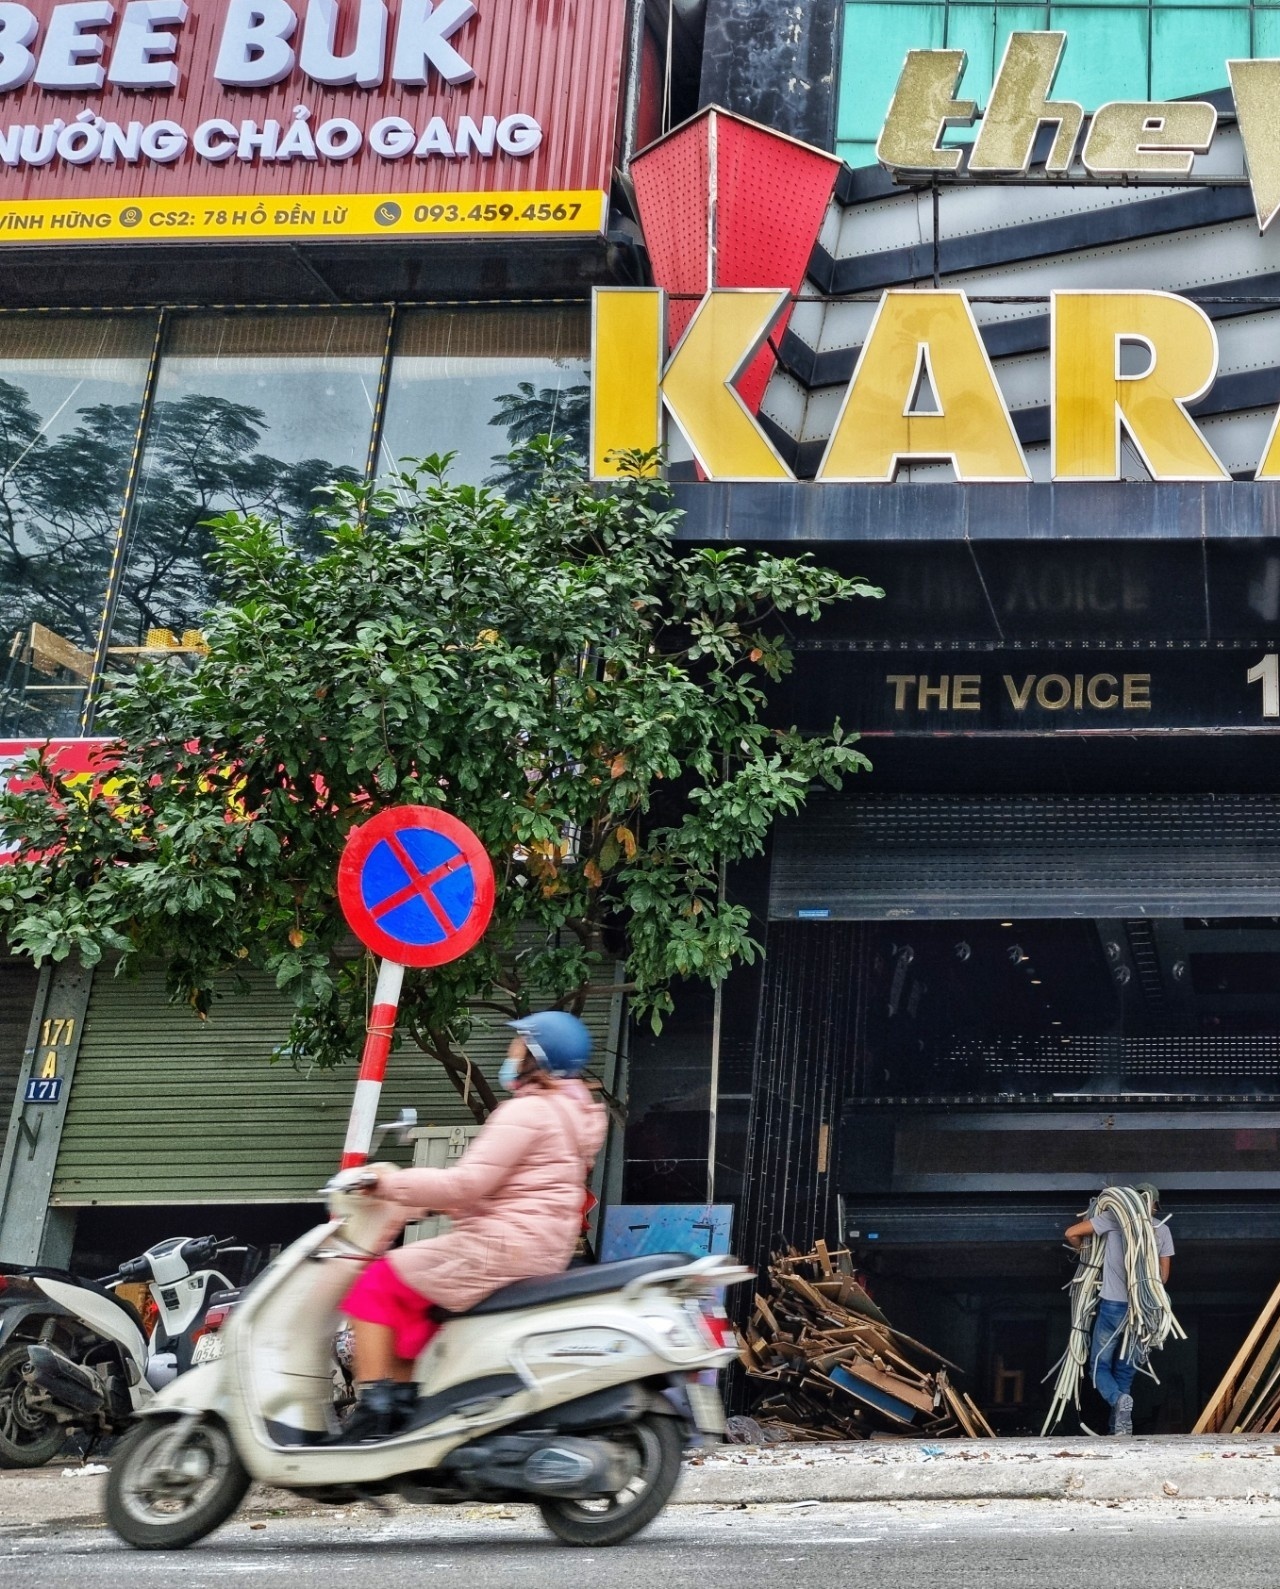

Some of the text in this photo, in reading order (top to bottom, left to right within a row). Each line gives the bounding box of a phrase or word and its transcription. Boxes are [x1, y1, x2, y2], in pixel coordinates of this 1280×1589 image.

[213, 0, 478, 88] BUK
[876, 31, 1217, 178] the
[0, 104, 543, 166] NƯỚNG CHẢO GANG
[149, 211, 195, 226] CS2:
[203, 210, 228, 226] 78
[274, 203, 316, 225] ĐỀN
[414, 203, 582, 223] 093.459.4567
[886, 673, 1151, 711] THE VOICE
[42, 1018, 76, 1046] 171
[41, 1051, 58, 1079] A
[26, 1081, 58, 1099] 171
